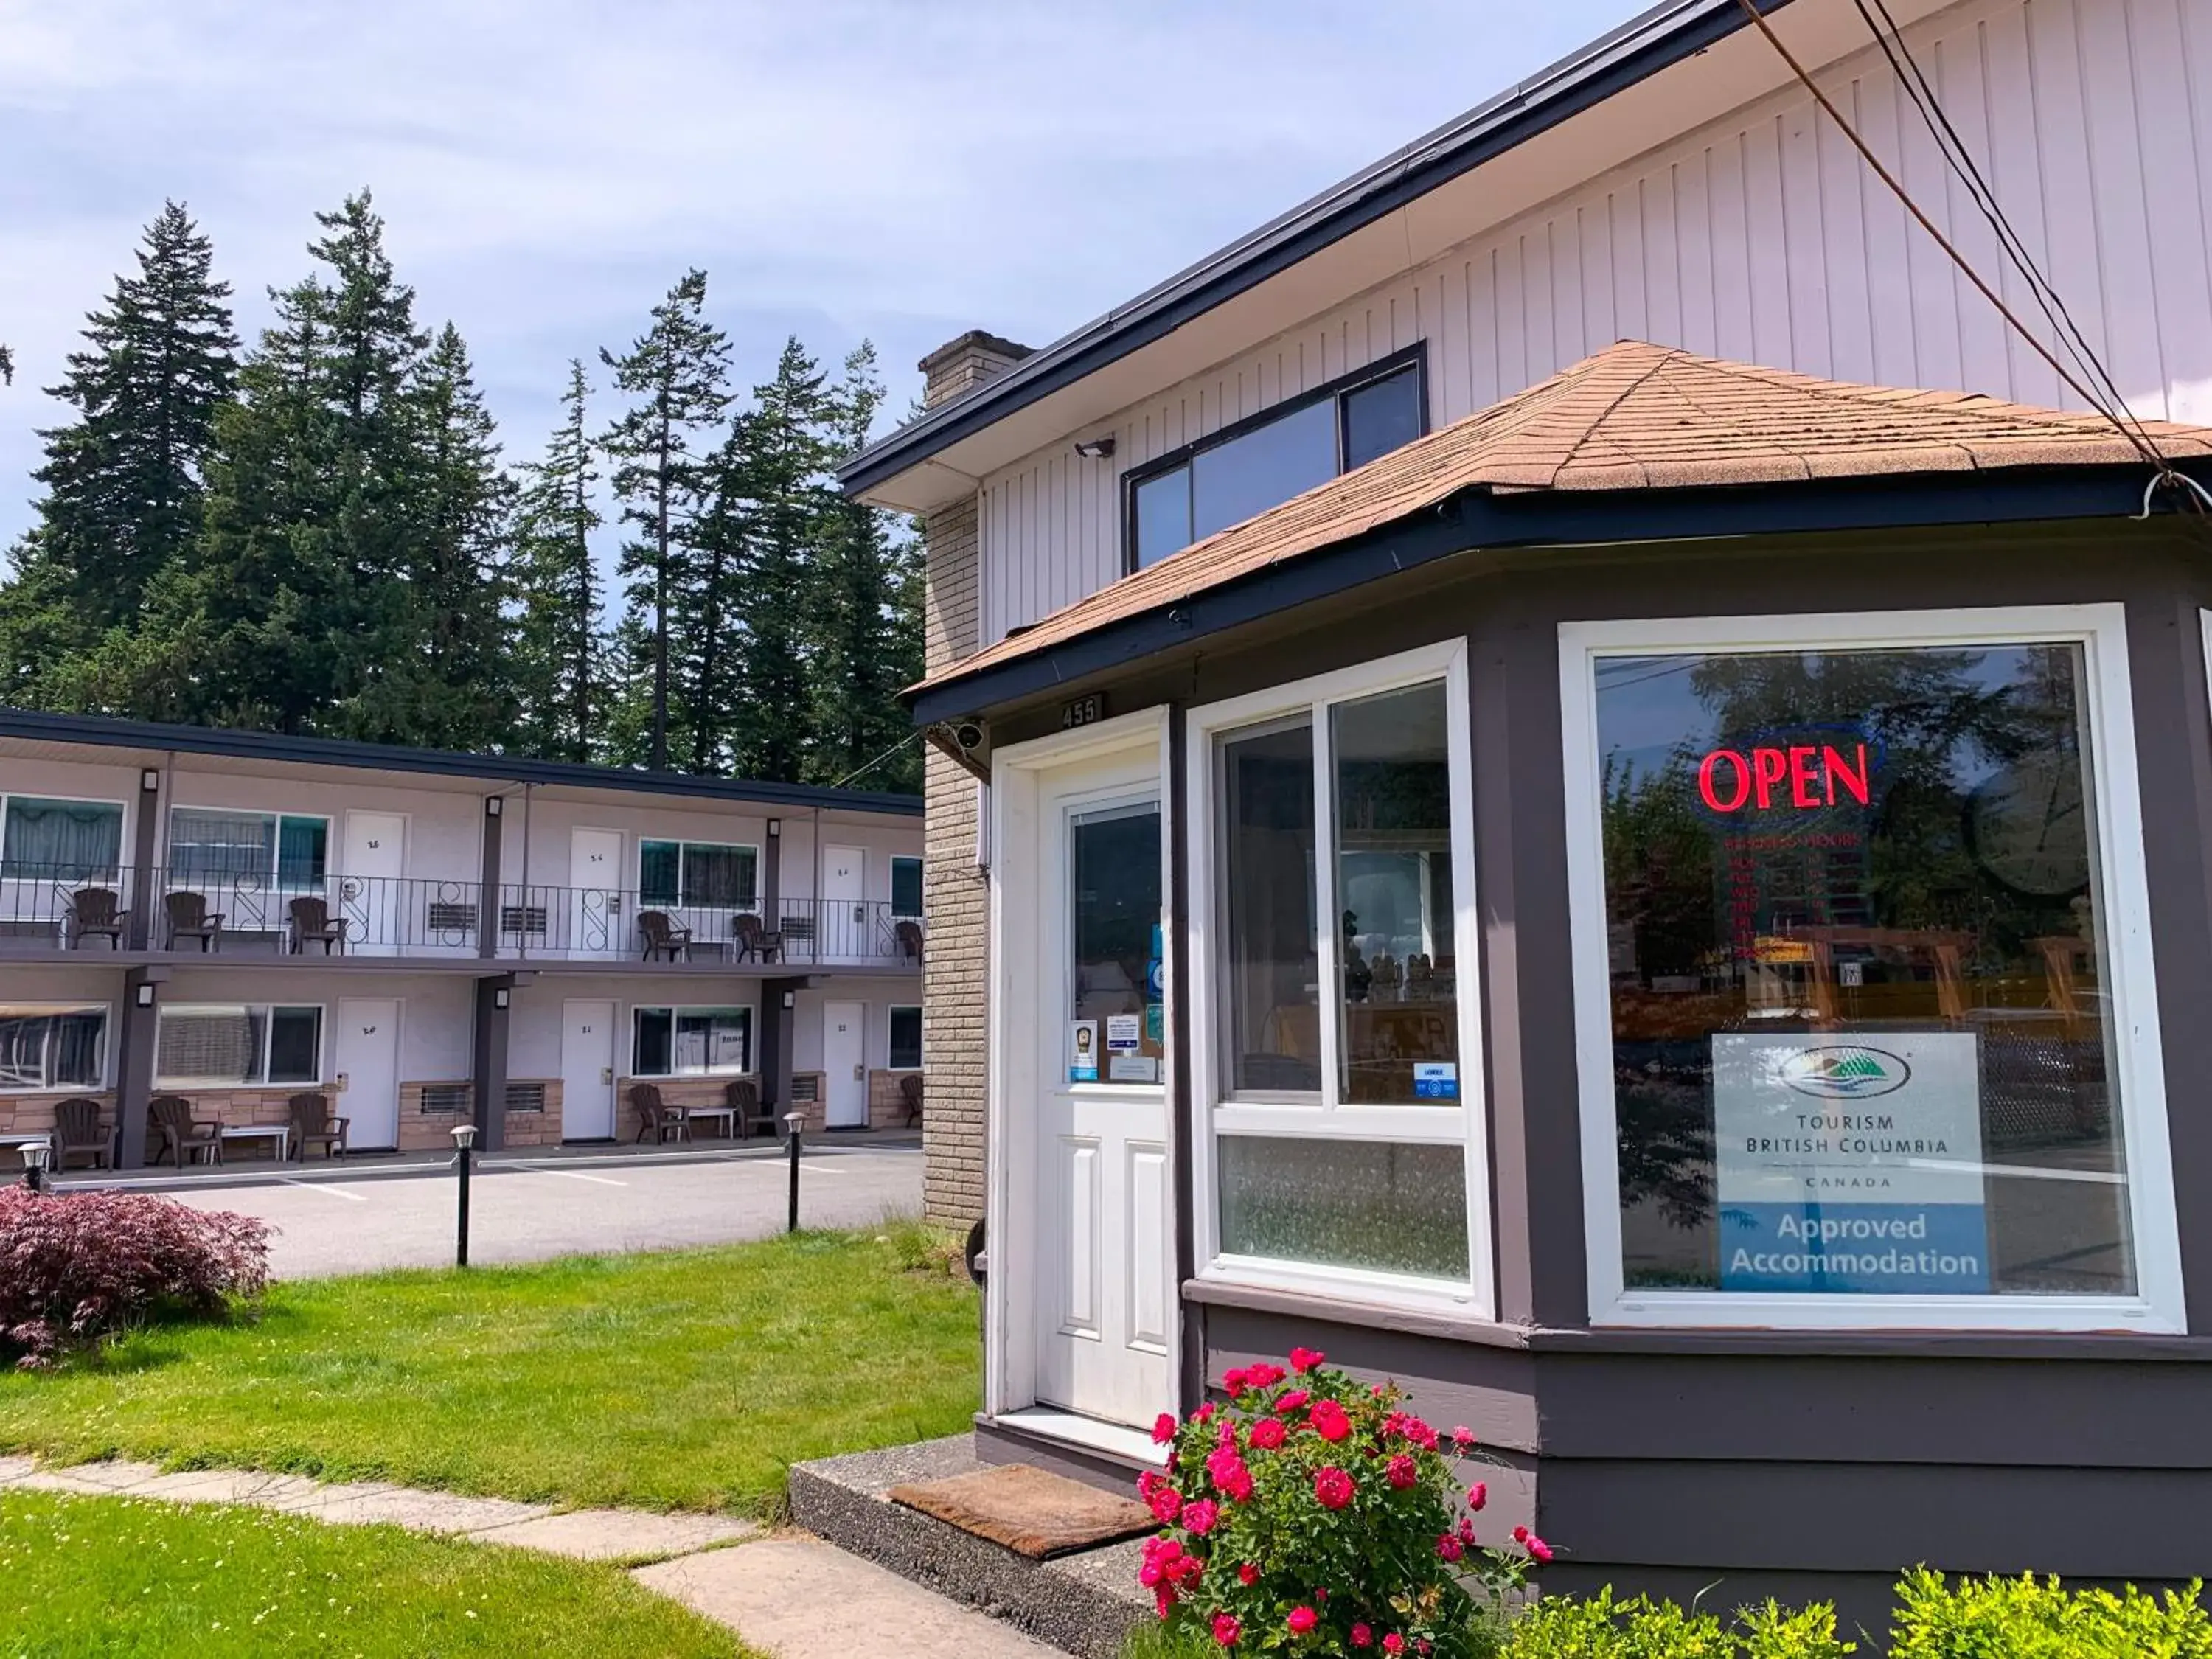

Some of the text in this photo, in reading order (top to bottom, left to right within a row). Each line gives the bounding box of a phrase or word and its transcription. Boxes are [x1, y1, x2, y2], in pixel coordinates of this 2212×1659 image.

[1062, 700, 1094, 728] 455
[1698, 743, 1869, 812] OPEN
[1796, 1114, 1893, 1130] TOURISM
[1747, 1138, 1948, 1153] BRITISH COLUMBIA
[1806, 1178, 1891, 1188] CANADA
[1777, 1213, 1927, 1244] Approved
[1730, 1247, 1979, 1275] Accommodation
